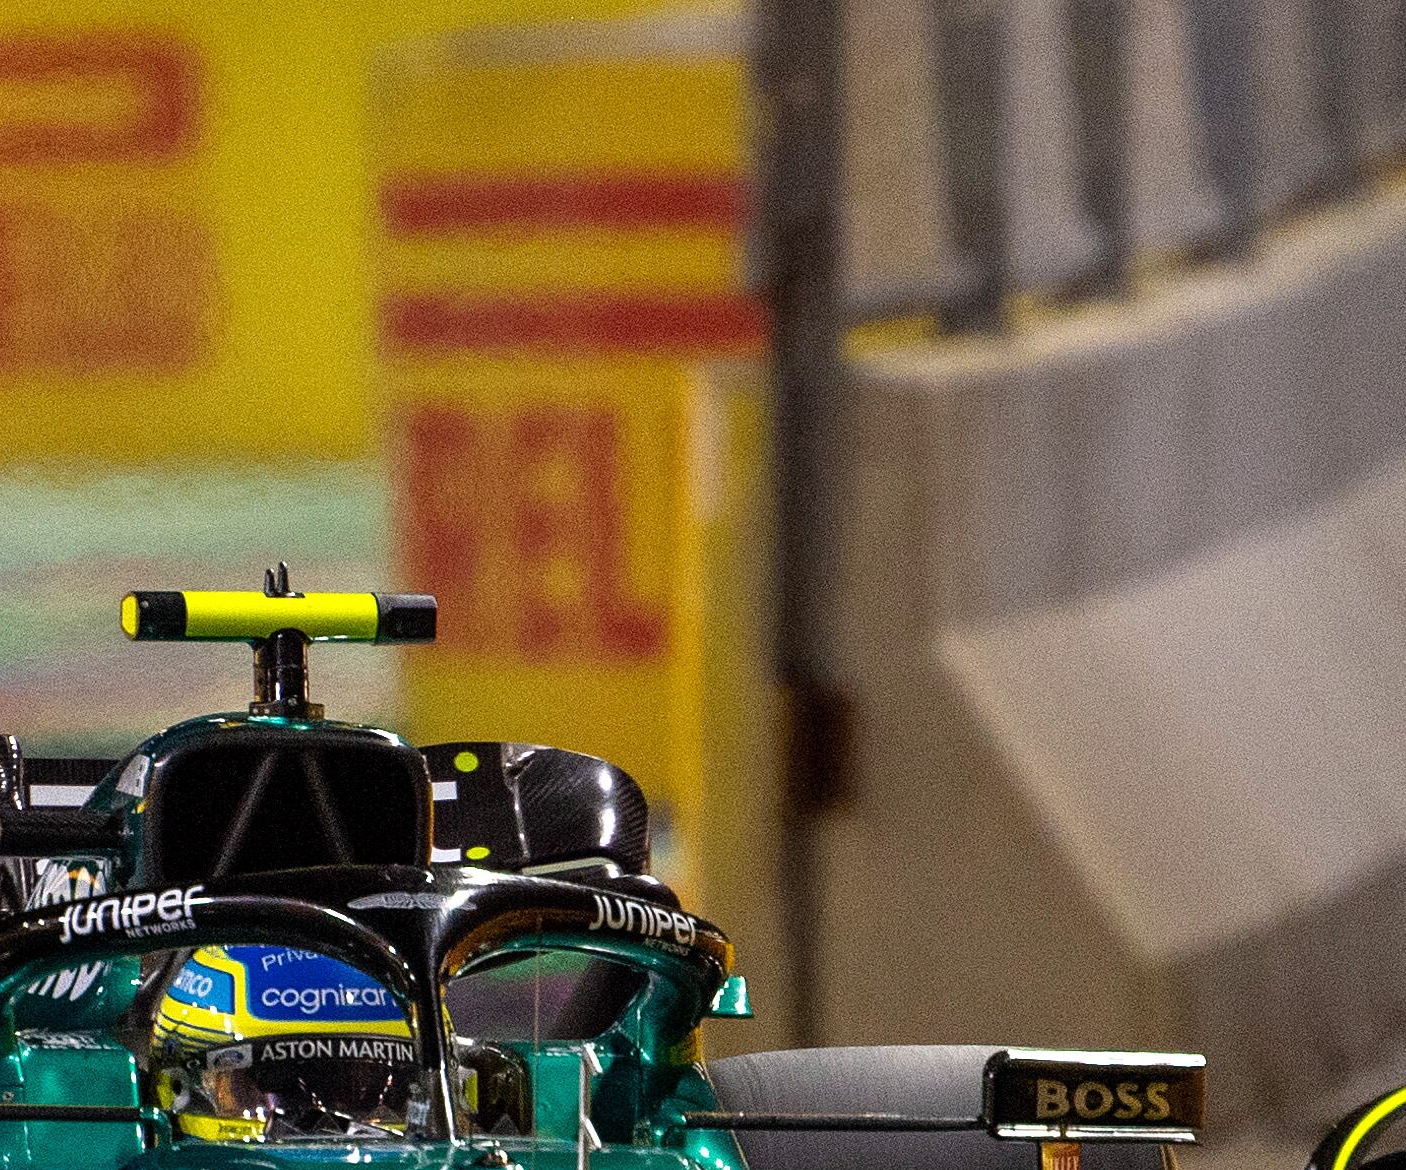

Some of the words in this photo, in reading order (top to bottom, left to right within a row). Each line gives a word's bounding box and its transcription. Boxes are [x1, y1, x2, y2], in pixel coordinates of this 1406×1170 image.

[260, 1039, 332, 1062] ASTON
[338, 1039, 415, 1063] MARTIN
[1036, 1078, 1170, 1120] BOSS
